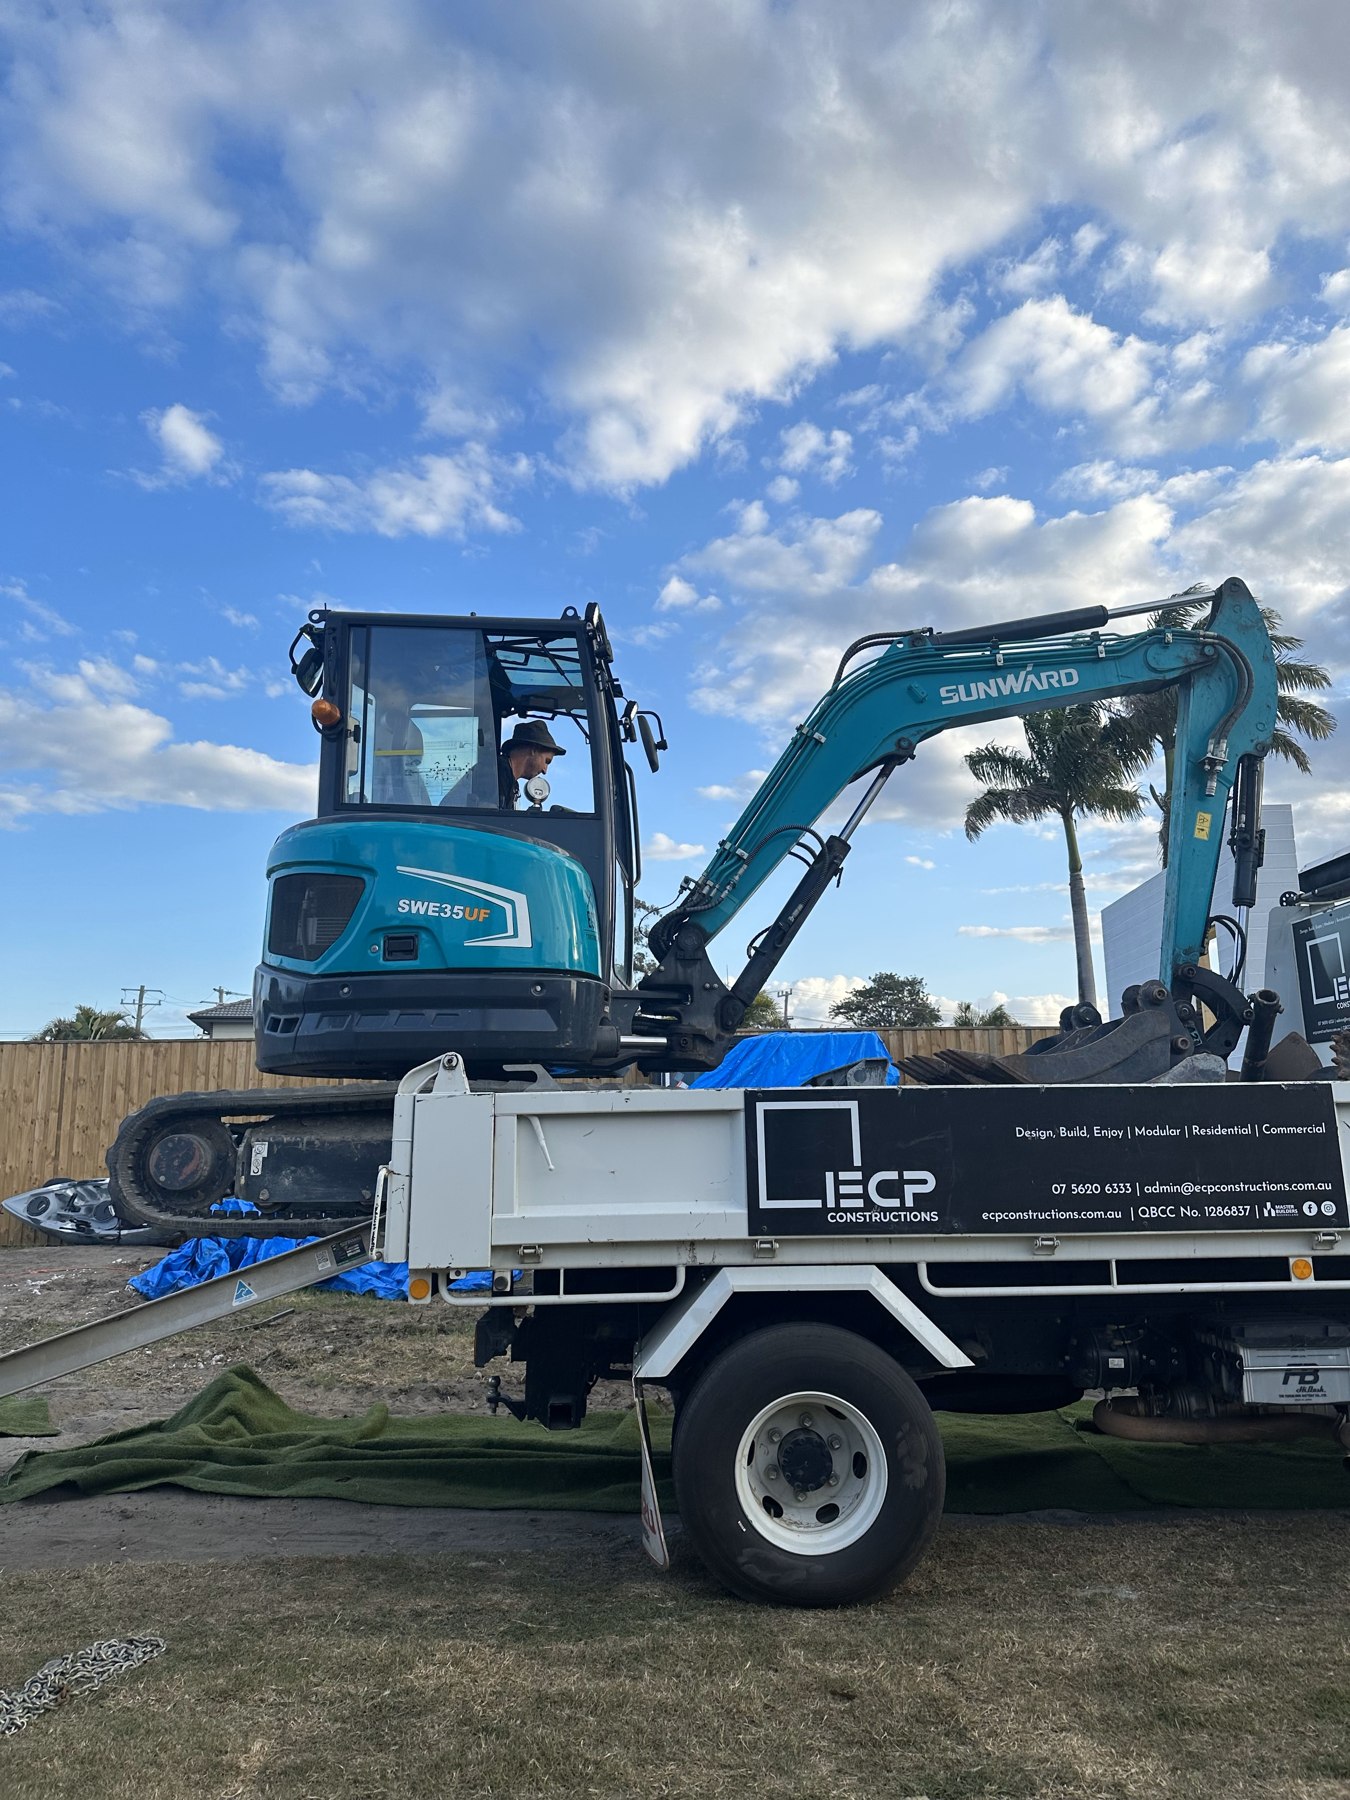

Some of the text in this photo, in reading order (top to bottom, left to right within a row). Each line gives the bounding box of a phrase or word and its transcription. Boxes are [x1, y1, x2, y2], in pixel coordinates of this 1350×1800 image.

[939, 663, 1079, 705] SUNWARD
[397, 899, 491, 923] SWE35UF
[1015, 1126, 1056, 1140] Design,
[1059, 1125, 1090, 1138] Build,
[1093, 1126, 1124, 1139] Enjoy
[1134, 1124, 1181, 1137] Modular
[1192, 1123, 1252, 1136] Residential
[1262, 1122, 1326, 1135] Commercial
[1051, 1183, 1067, 1195] 07
[1071, 1183, 1101, 1195] 5620
[1104, 1182, 1132, 1194] 6333
[1143, 1180, 1332, 1196] admin@ecpconstructions.com.au
[827, 1210, 939, 1223] CONSTRUCTIONS
[981, 1208, 1122, 1223] ecpconstructions.com.au
[1137, 1206, 1176, 1218] QBCC
[1179, 1205, 1201, 1218] No.
[1204, 1205, 1251, 1217] 1286837
